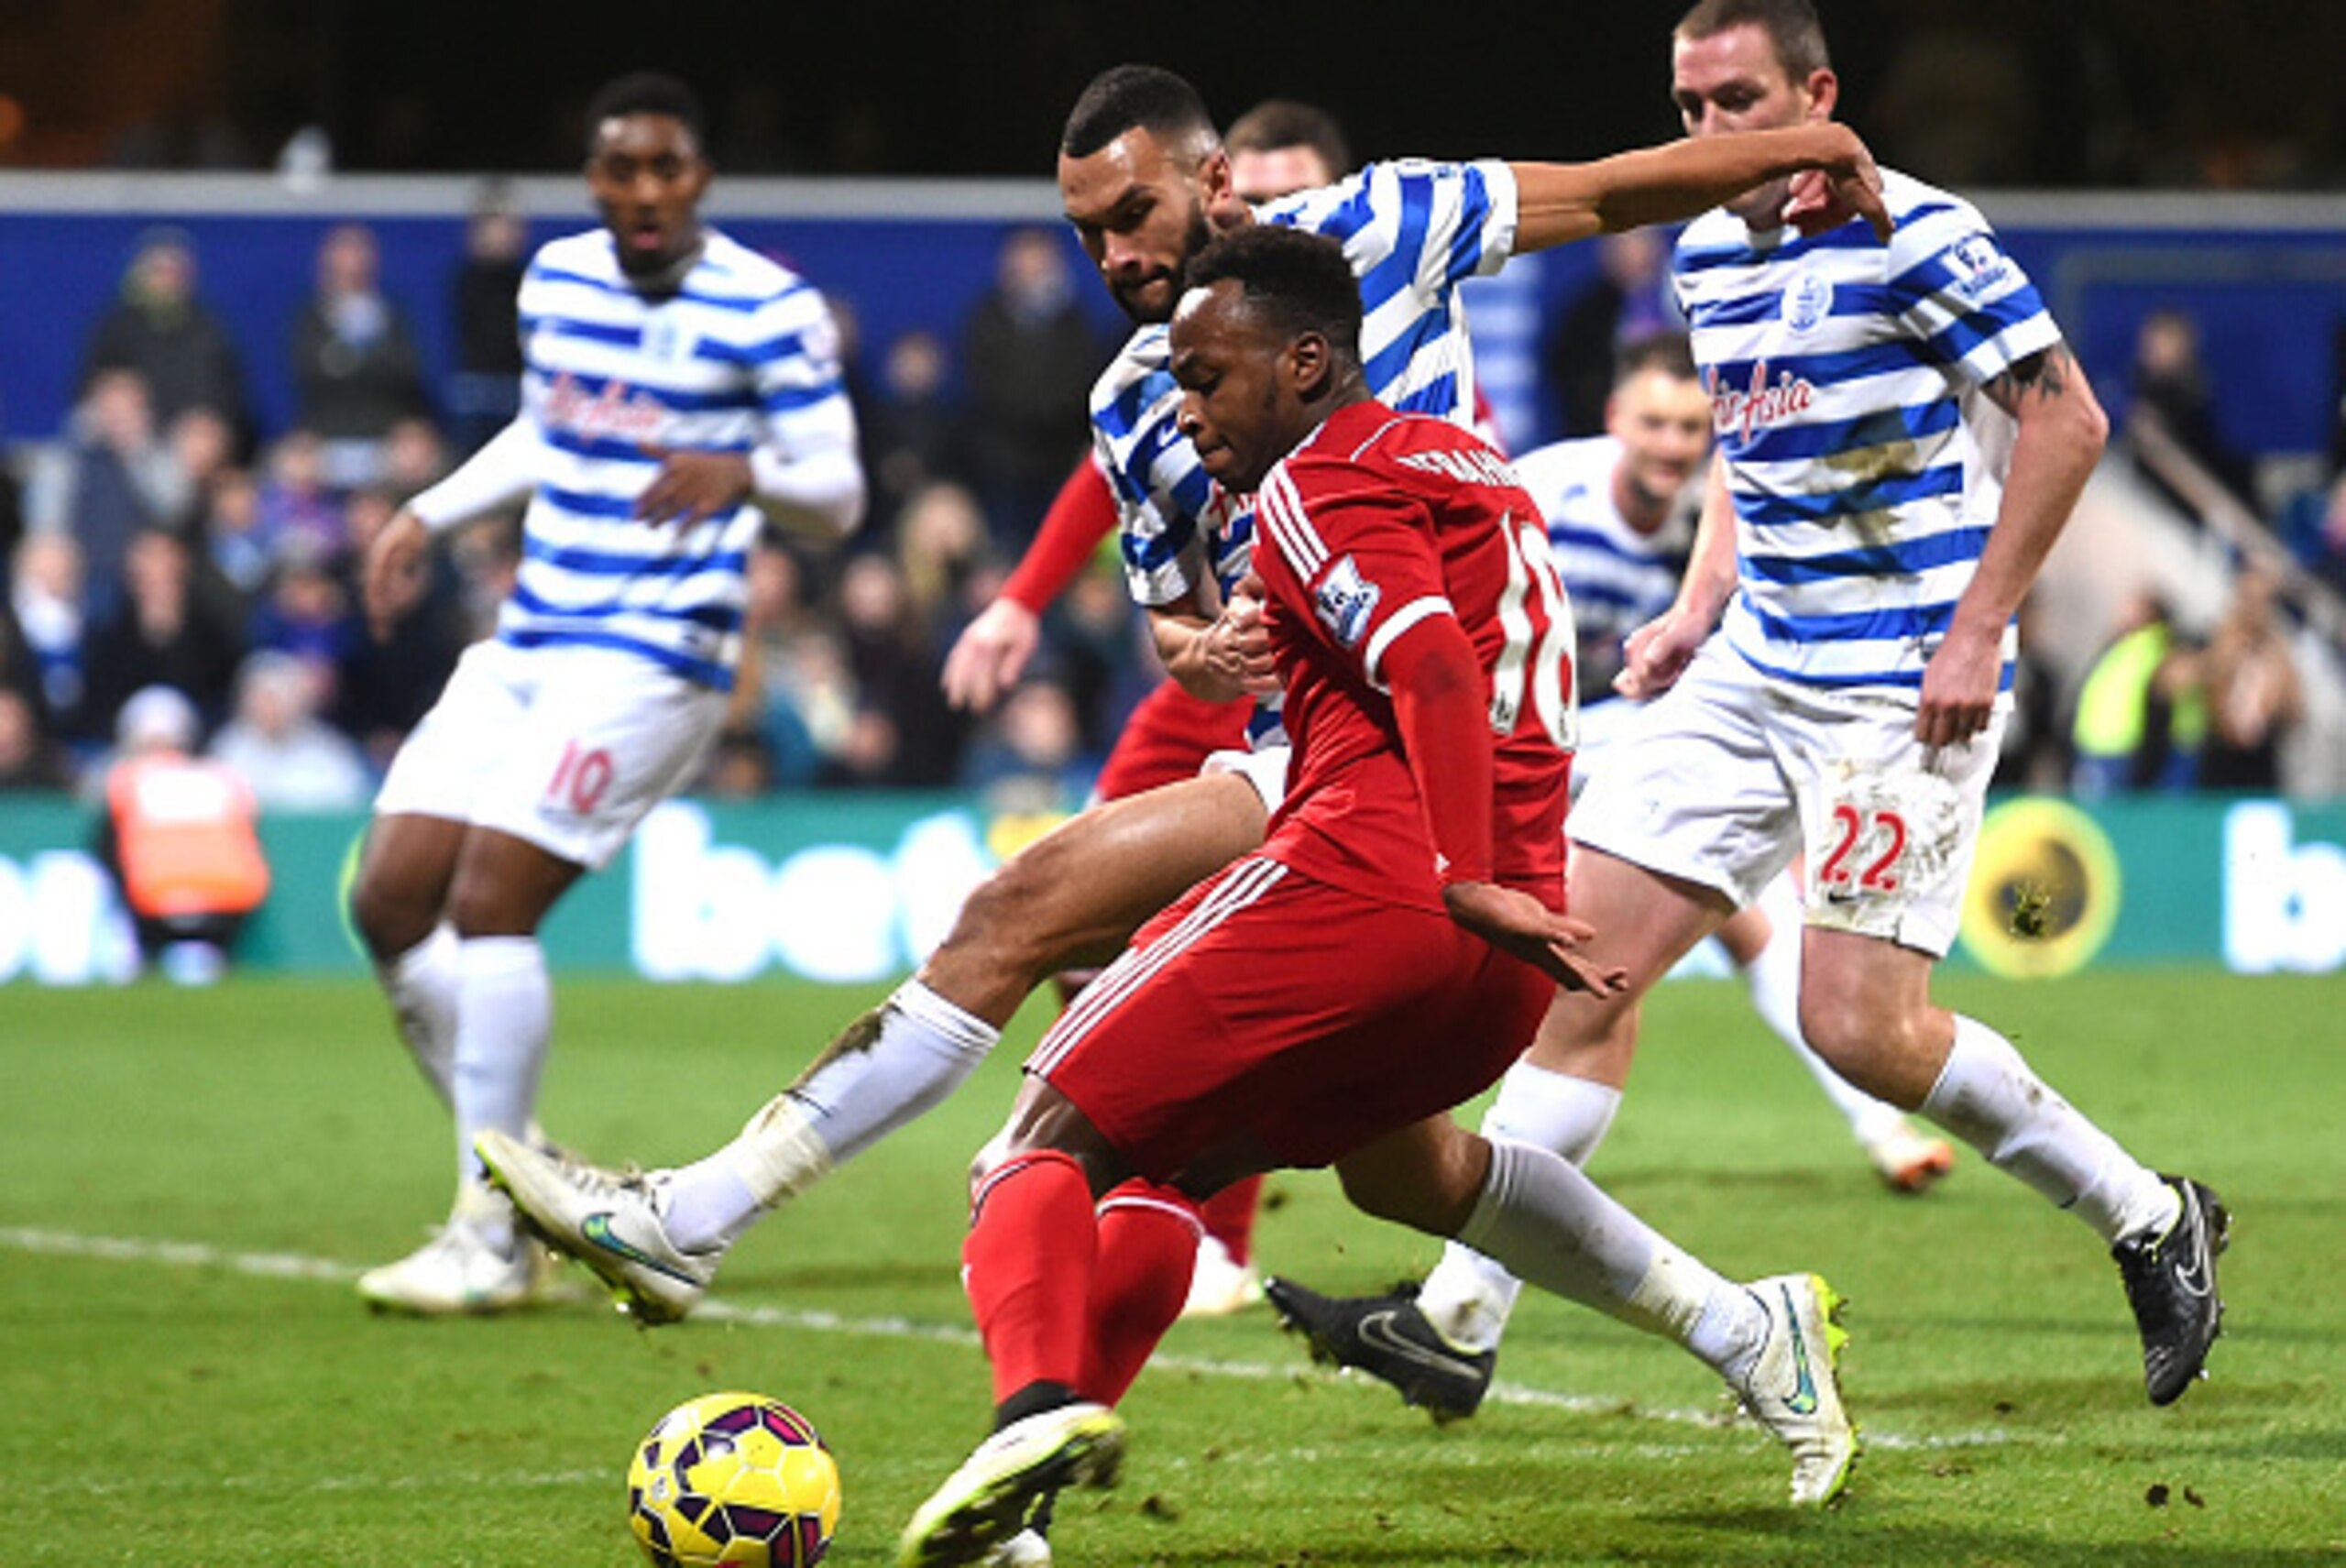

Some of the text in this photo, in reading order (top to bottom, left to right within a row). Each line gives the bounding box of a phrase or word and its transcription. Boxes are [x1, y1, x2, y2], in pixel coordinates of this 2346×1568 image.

[1494, 509, 1580, 751] 18
[547, 737, 613, 814] 10
[1819, 805, 1906, 892] 22
